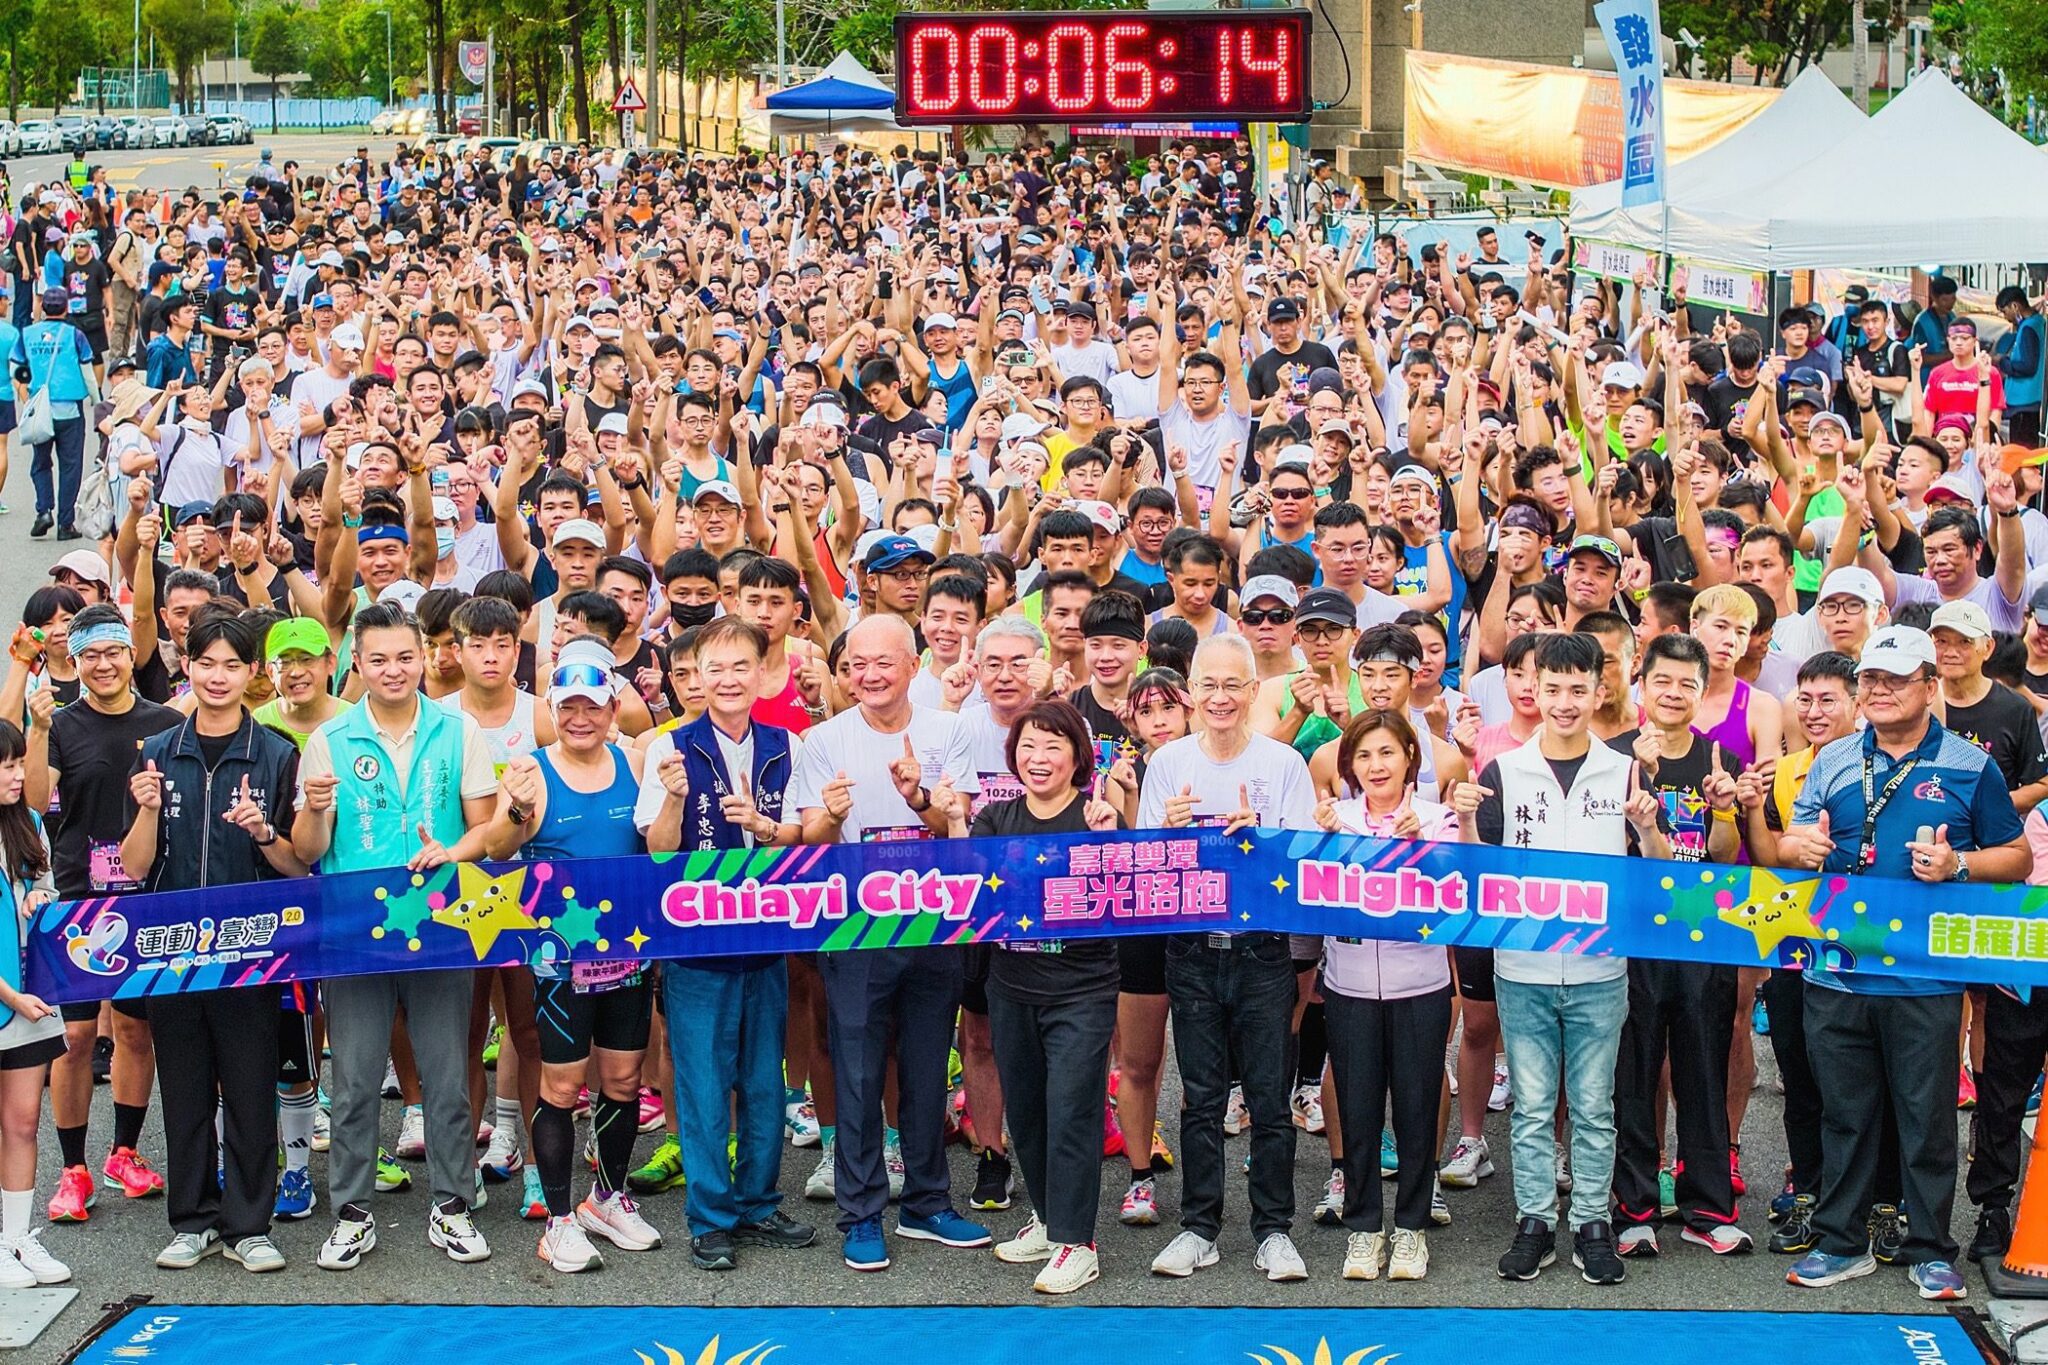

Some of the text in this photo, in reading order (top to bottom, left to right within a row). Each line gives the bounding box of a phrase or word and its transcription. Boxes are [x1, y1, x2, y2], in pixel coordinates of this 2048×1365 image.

[1613, 13, 1656, 190] 發水區
[985, 788, 1023, 798] 10268
[1535, 791, 1548, 824] 議員
[878, 846, 921, 859] 90005
[1069, 840, 1199, 875] 嘉義雙潭
[663, 869, 984, 926] Chiayi City
[1044, 870, 1227, 921] 星光路跑
[1300, 861, 1607, 921] Night RUN
[285, 910, 301, 922] 2.0
